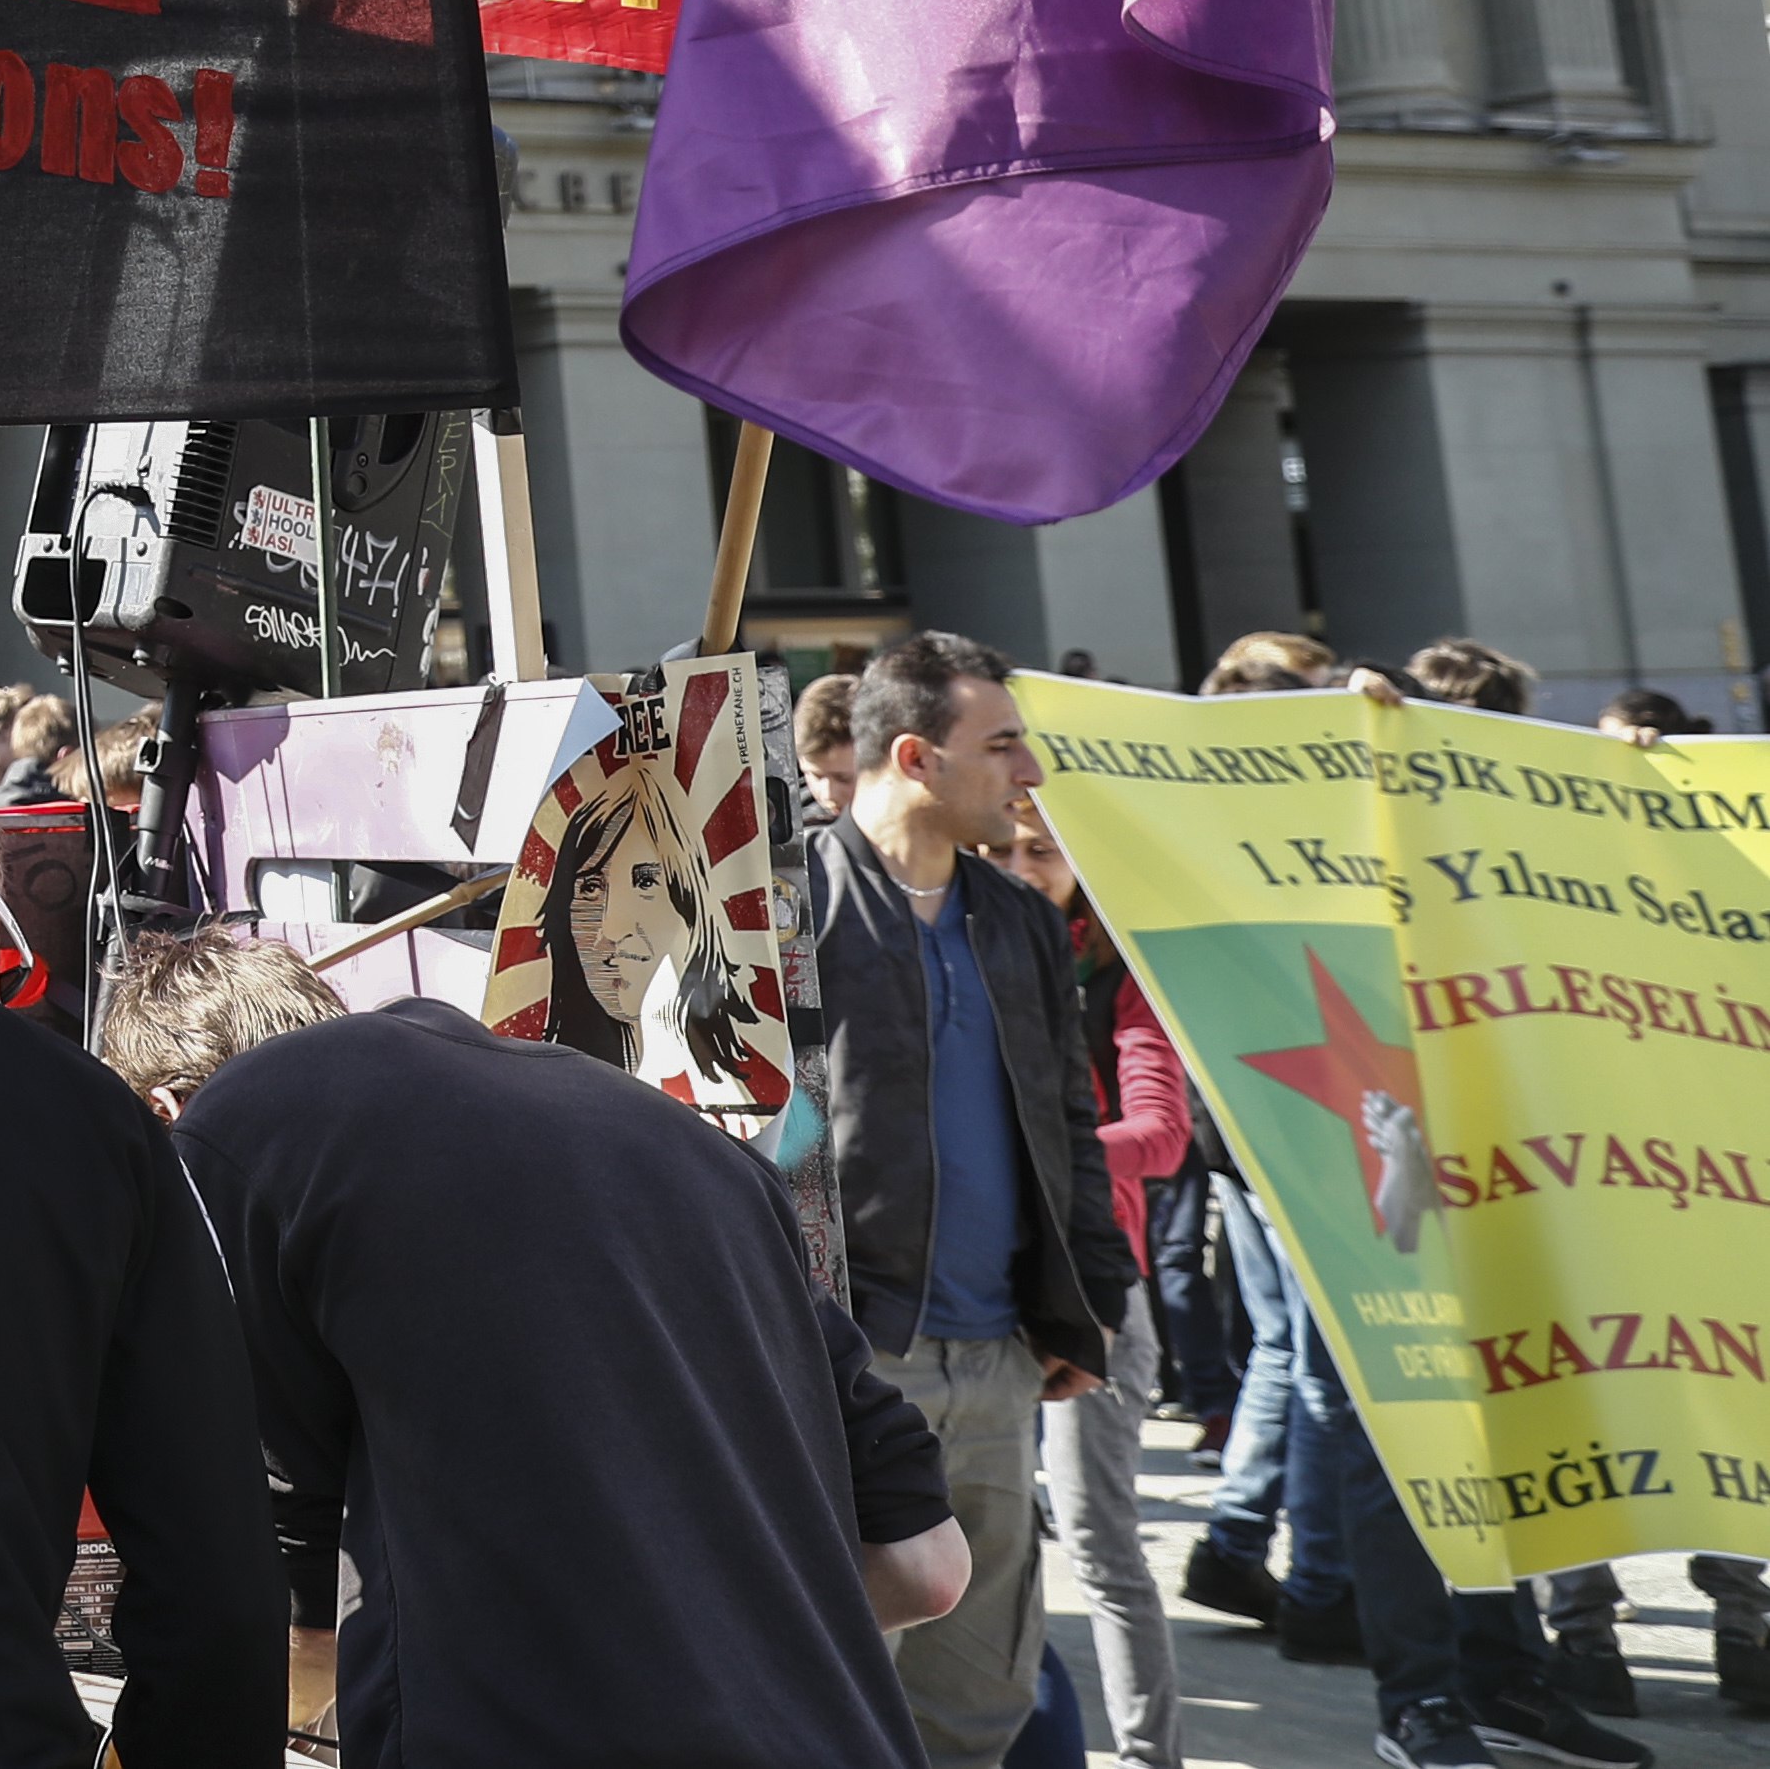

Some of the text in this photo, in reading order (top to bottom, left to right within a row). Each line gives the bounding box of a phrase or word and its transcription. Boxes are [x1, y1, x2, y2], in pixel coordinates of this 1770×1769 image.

[267, 515, 317, 541] HOOL
[271, 494, 316, 521] ULTR
[613, 695, 673, 758] REE
[732, 666, 751, 765] FREENEKANE.CH
[1036, 732, 1308, 786] HALKLARIN
[1468, 1312, 1768, 1394] KAZAN
